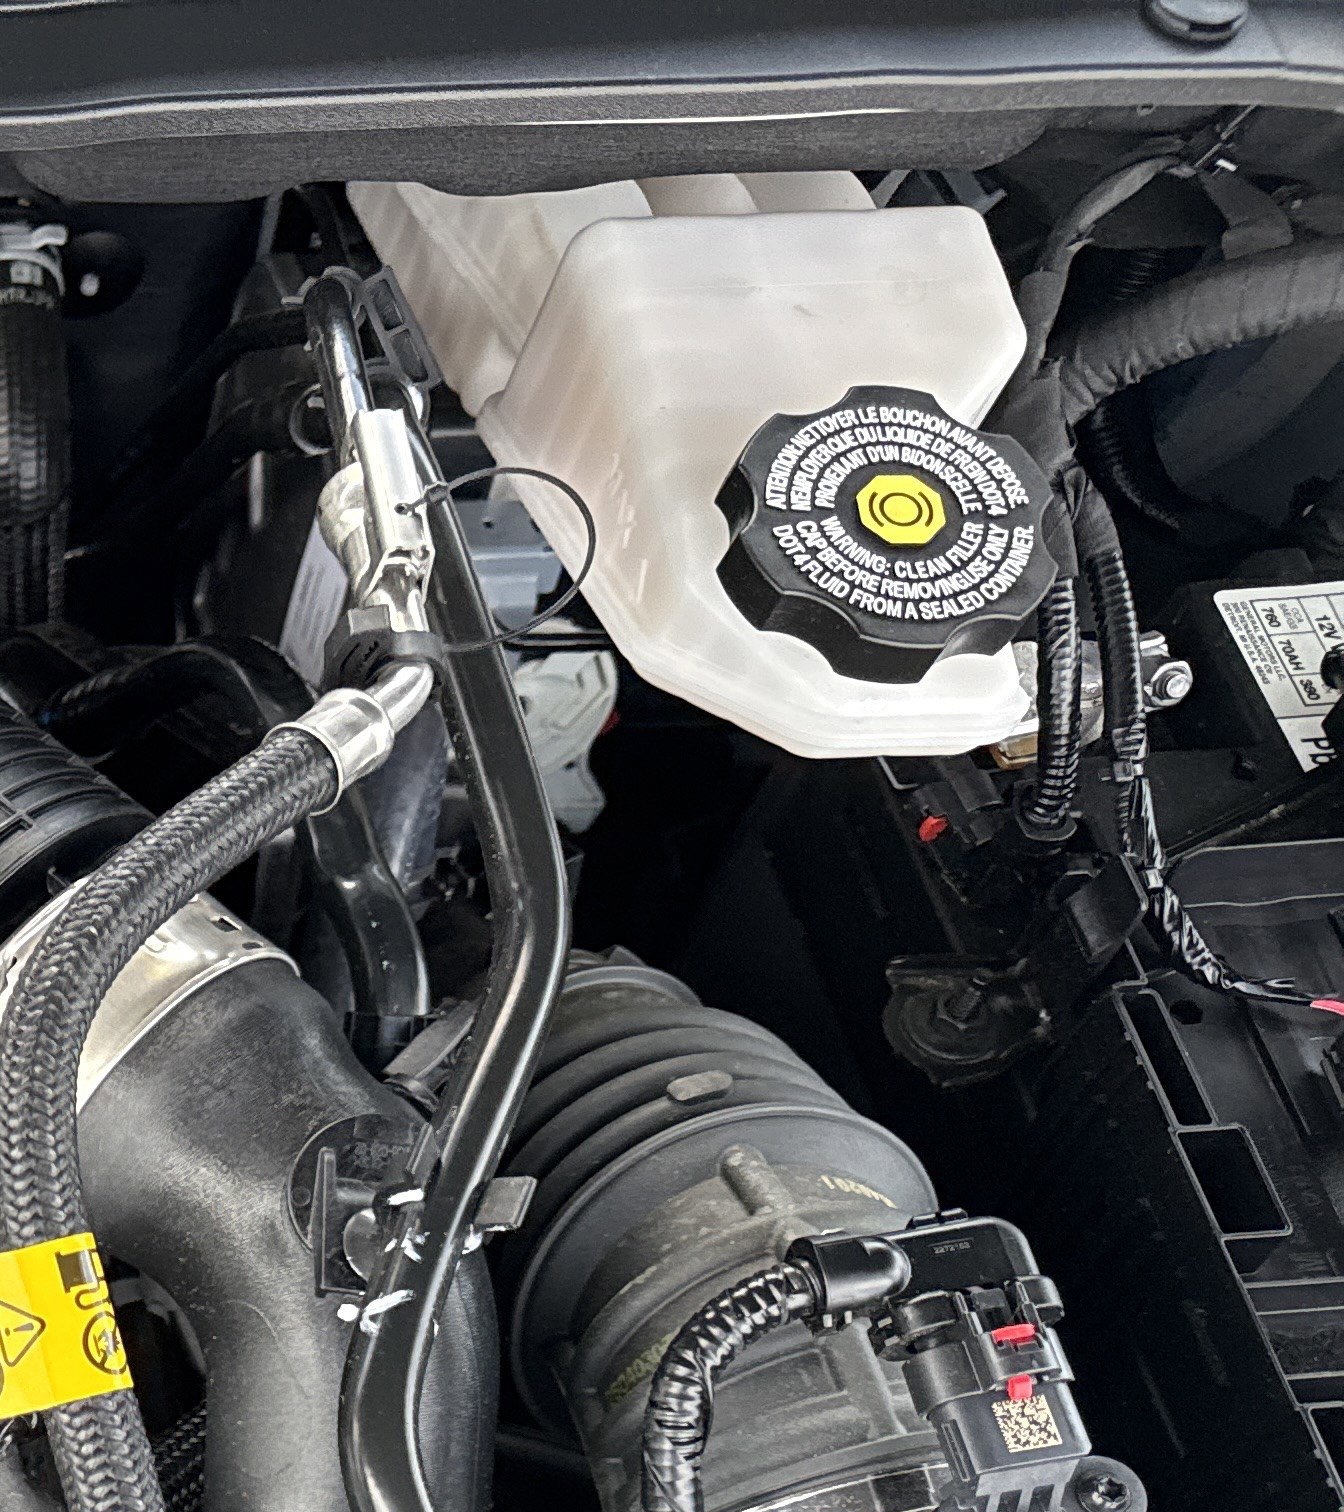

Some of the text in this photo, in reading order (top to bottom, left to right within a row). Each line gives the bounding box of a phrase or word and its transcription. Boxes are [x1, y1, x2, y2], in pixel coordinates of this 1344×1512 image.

[790, 409, 859, 453] NETTOYER
[857, 406, 879, 421] LE
[879, 406, 951, 437] BOUCHON
[947, 426, 997, 461] AVANT
[826, 429, 859, 457] QUE
[854, 427, 878, 444] DU
[876, 425, 934, 450] LIQUIDE
[930, 437, 955, 459] DE
[814, 448, 869, 509] PROVENANT
[866, 445, 900, 463] D'UN
[901, 446, 946, 475] BIDON
[949, 448, 990, 484] FREIN
[976, 480, 1005, 506] DOT
[987, 504, 1008, 516] 4
[796, 520, 828, 549] CAP
[816, 546, 881, 593] BEFORE
[960, 555, 996, 584] USE
[981, 523, 1009, 561] ONLY
[820, 515, 984, 579] WARNING: CLEAN FILLER
[772, 524, 1034, 620] DOT 4 FLUID FROM A SEALED CONTAINER.
